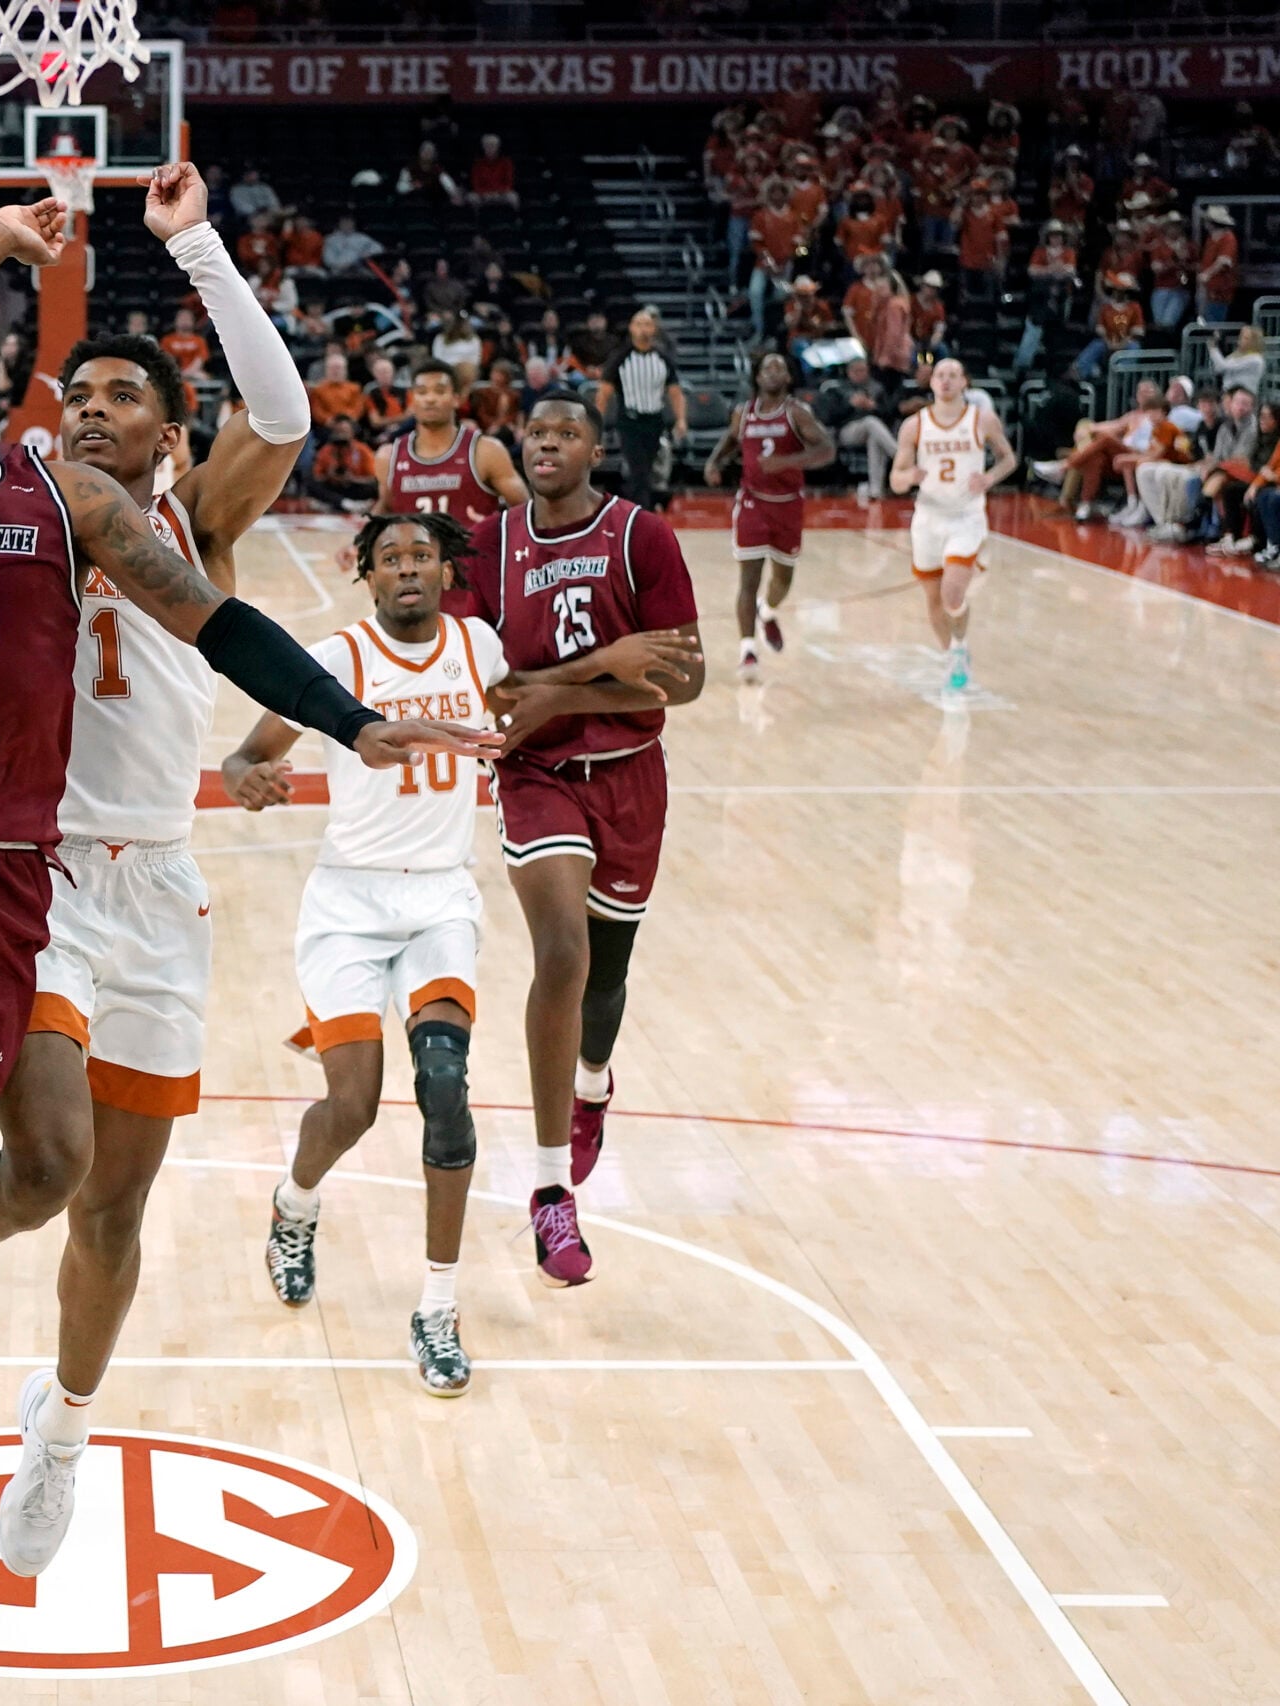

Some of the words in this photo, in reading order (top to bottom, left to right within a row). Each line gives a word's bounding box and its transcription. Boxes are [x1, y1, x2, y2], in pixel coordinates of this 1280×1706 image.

[287, 54, 344, 94] OF
[358, 54, 451, 94] THE
[467, 54, 616, 95] TEXAS
[1056, 49, 1192, 90] HOOK
[939, 458, 956, 482] 2
[552, 585, 597, 659] 25
[89, 607, 132, 700] 1
[373, 691, 472, 722] TEXAS
